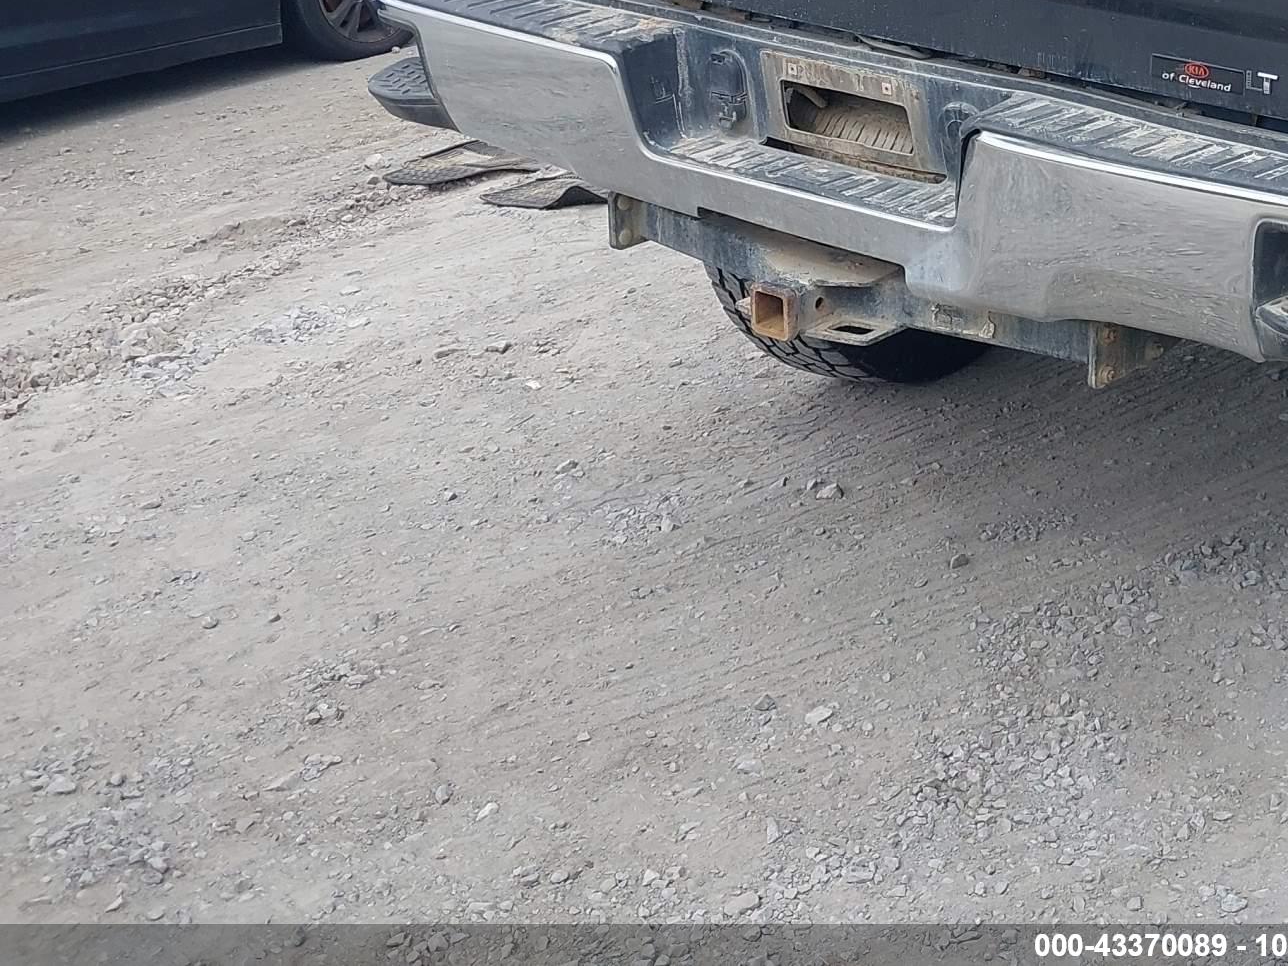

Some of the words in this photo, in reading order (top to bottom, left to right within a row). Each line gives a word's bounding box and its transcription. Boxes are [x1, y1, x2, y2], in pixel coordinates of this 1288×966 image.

[1187, 64, 1207, 77] KIA
[1161, 72, 1175, 81] of
[1178, 74, 1231, 92] Cleveland
